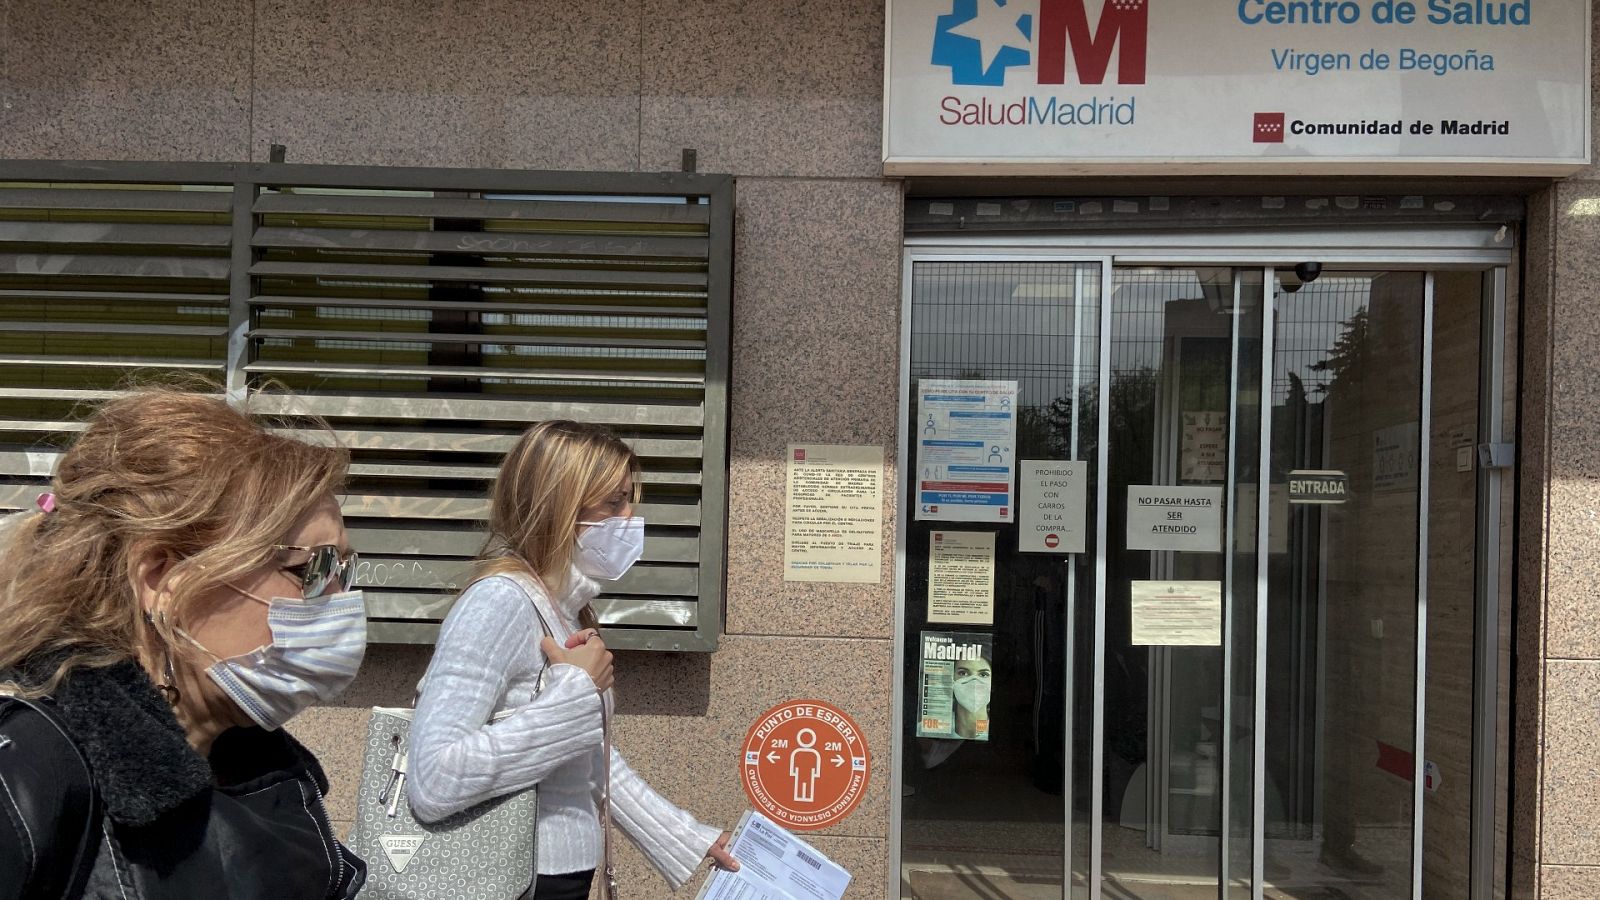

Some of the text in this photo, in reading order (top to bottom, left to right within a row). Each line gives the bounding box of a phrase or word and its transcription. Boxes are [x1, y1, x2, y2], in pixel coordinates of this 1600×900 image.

[1238, 0, 1530, 24] Centro de Salud
[1271, 48, 1494, 76] Virgen de Begoña
[940, 96, 1134, 125] SaludMadrid
[1290, 120, 1509, 136] Comunidad de Madrid
[1290, 480, 1344, 494] ENTRADA
[1167, 511, 1182, 519] SER
[1152, 524, 1196, 533] ATENDIDO
[924, 642, 982, 661] Madrid!
[756, 706, 857, 744] PUNTO DE ESPERA
[771, 739, 788, 748] 2M
[824, 742, 842, 752] 2M
[749, 769, 862, 822] MANTENGA DISTANCIA DE SEGURIDAD
[386, 839, 417, 848] GUESS
